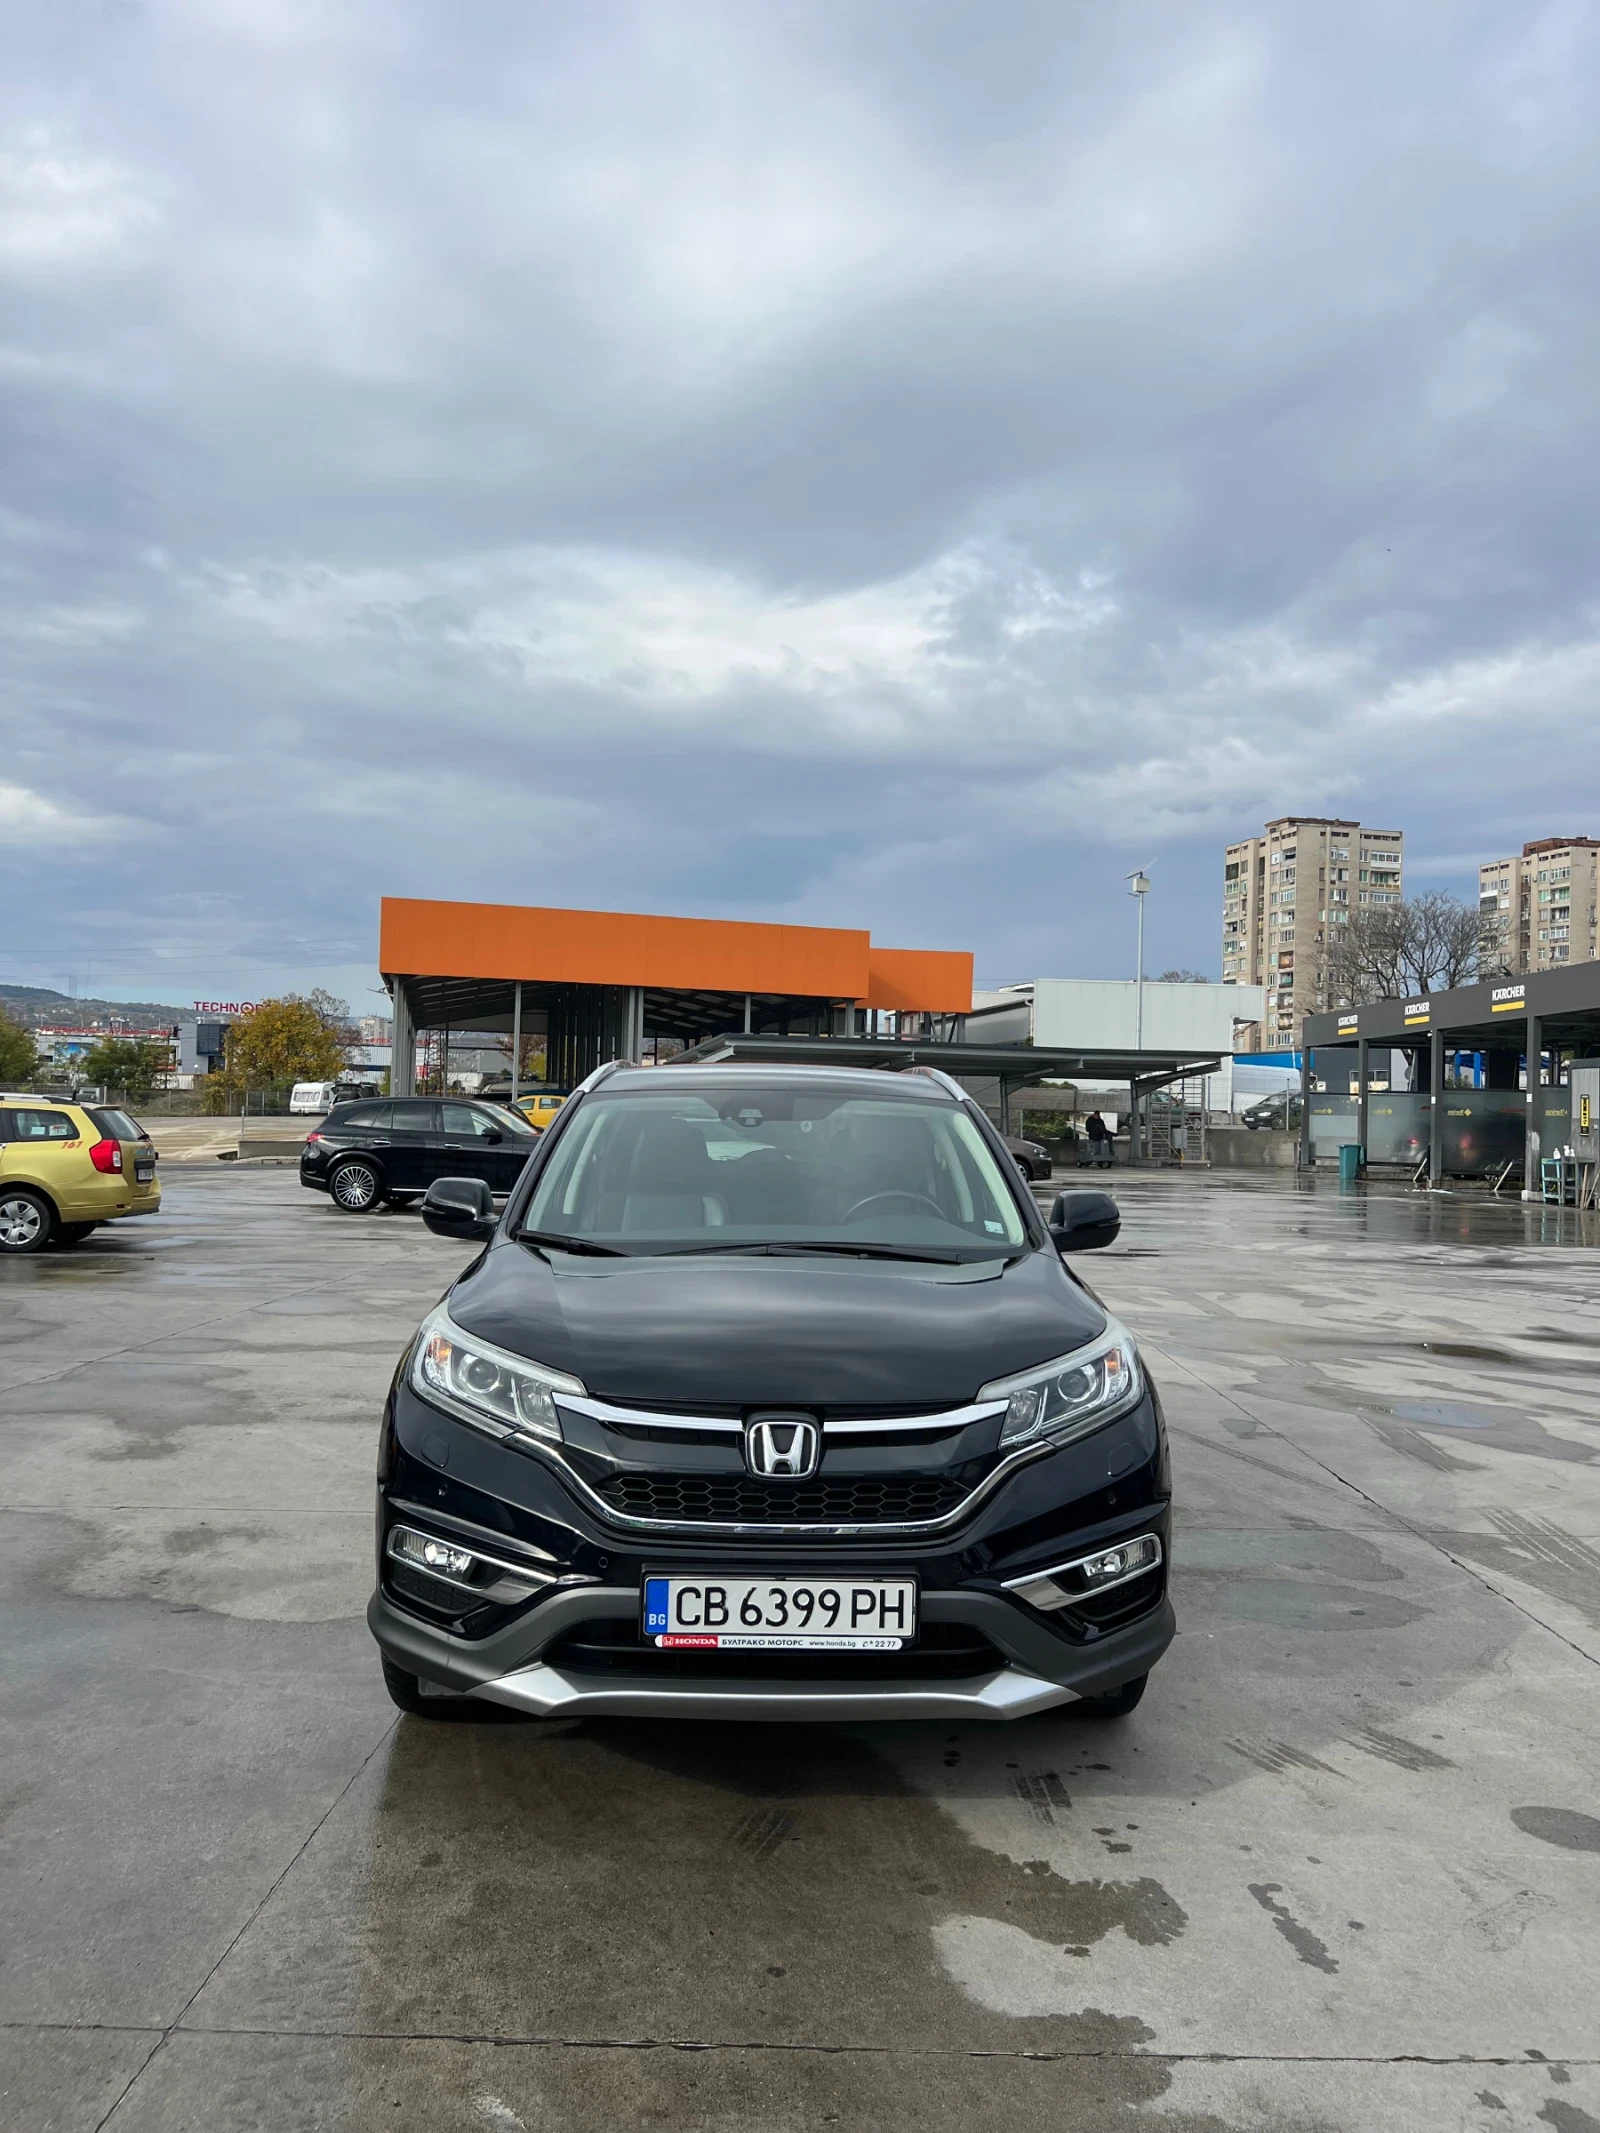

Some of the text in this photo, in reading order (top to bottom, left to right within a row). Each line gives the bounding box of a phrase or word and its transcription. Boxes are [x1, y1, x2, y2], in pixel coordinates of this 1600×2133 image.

[676, 1586, 905, 1629] CB 6399 PH
[648, 1613, 666, 1626] BG
[674, 1637, 717, 1645] HONDA
[767, 1639, 804, 1647] МОТОРС
[808, 1640, 856, 1648] www.honda.bg
